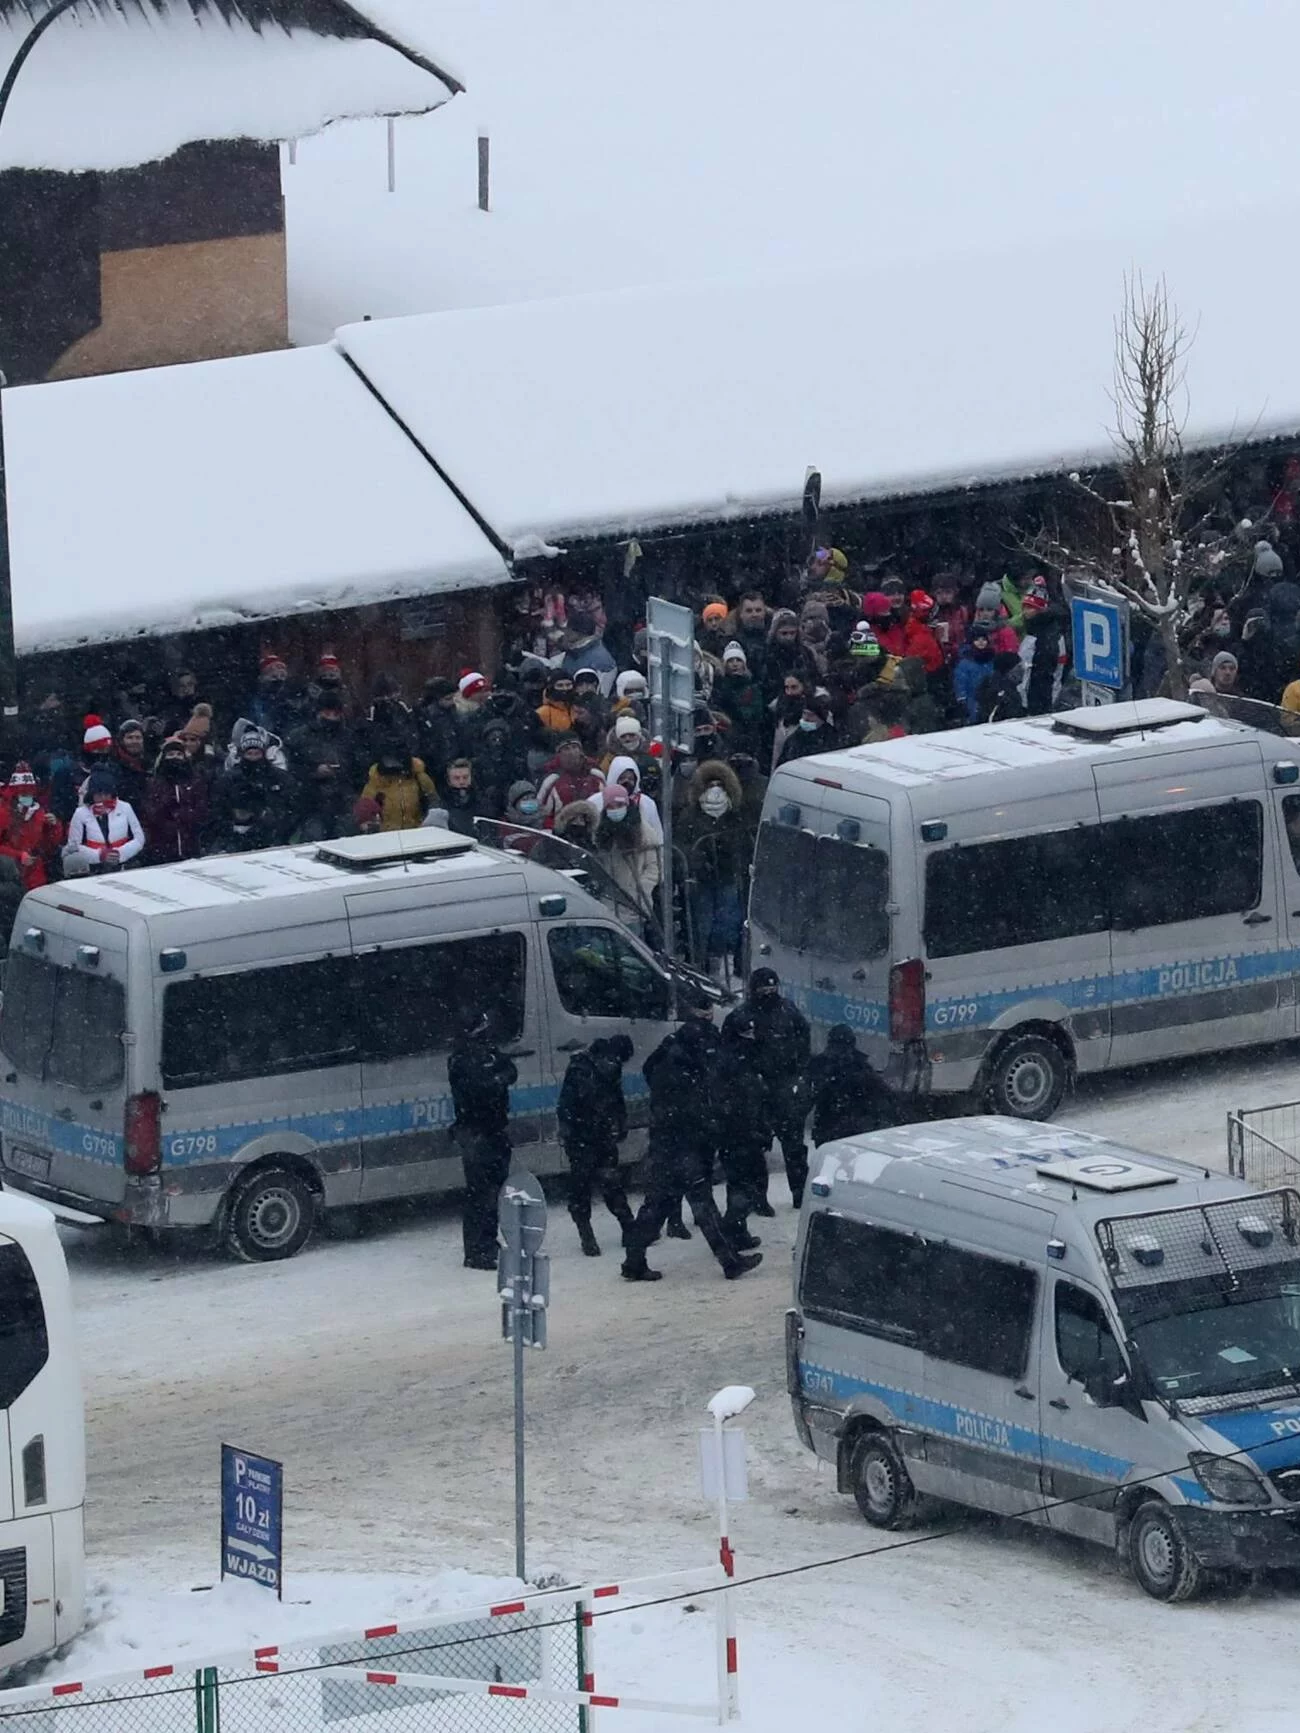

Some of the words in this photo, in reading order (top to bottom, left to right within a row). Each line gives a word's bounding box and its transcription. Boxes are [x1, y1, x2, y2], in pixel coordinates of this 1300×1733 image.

[1083, 610, 1110, 672] P
[1159, 960, 1237, 992] POLICJA
[843, 1004, 880, 1025] G799
[934, 1003, 977, 1025] G799
[412, 1100, 453, 1126] POL
[82, 1132, 117, 1158] G798
[170, 1134, 217, 1157] G798
[804, 1370, 834, 1393] G747
[956, 1412, 1010, 1448] POLICJA
[235, 1457, 247, 1485] P
[235, 1491, 257, 1524] 10
[227, 1553, 277, 1584] WJAZD
